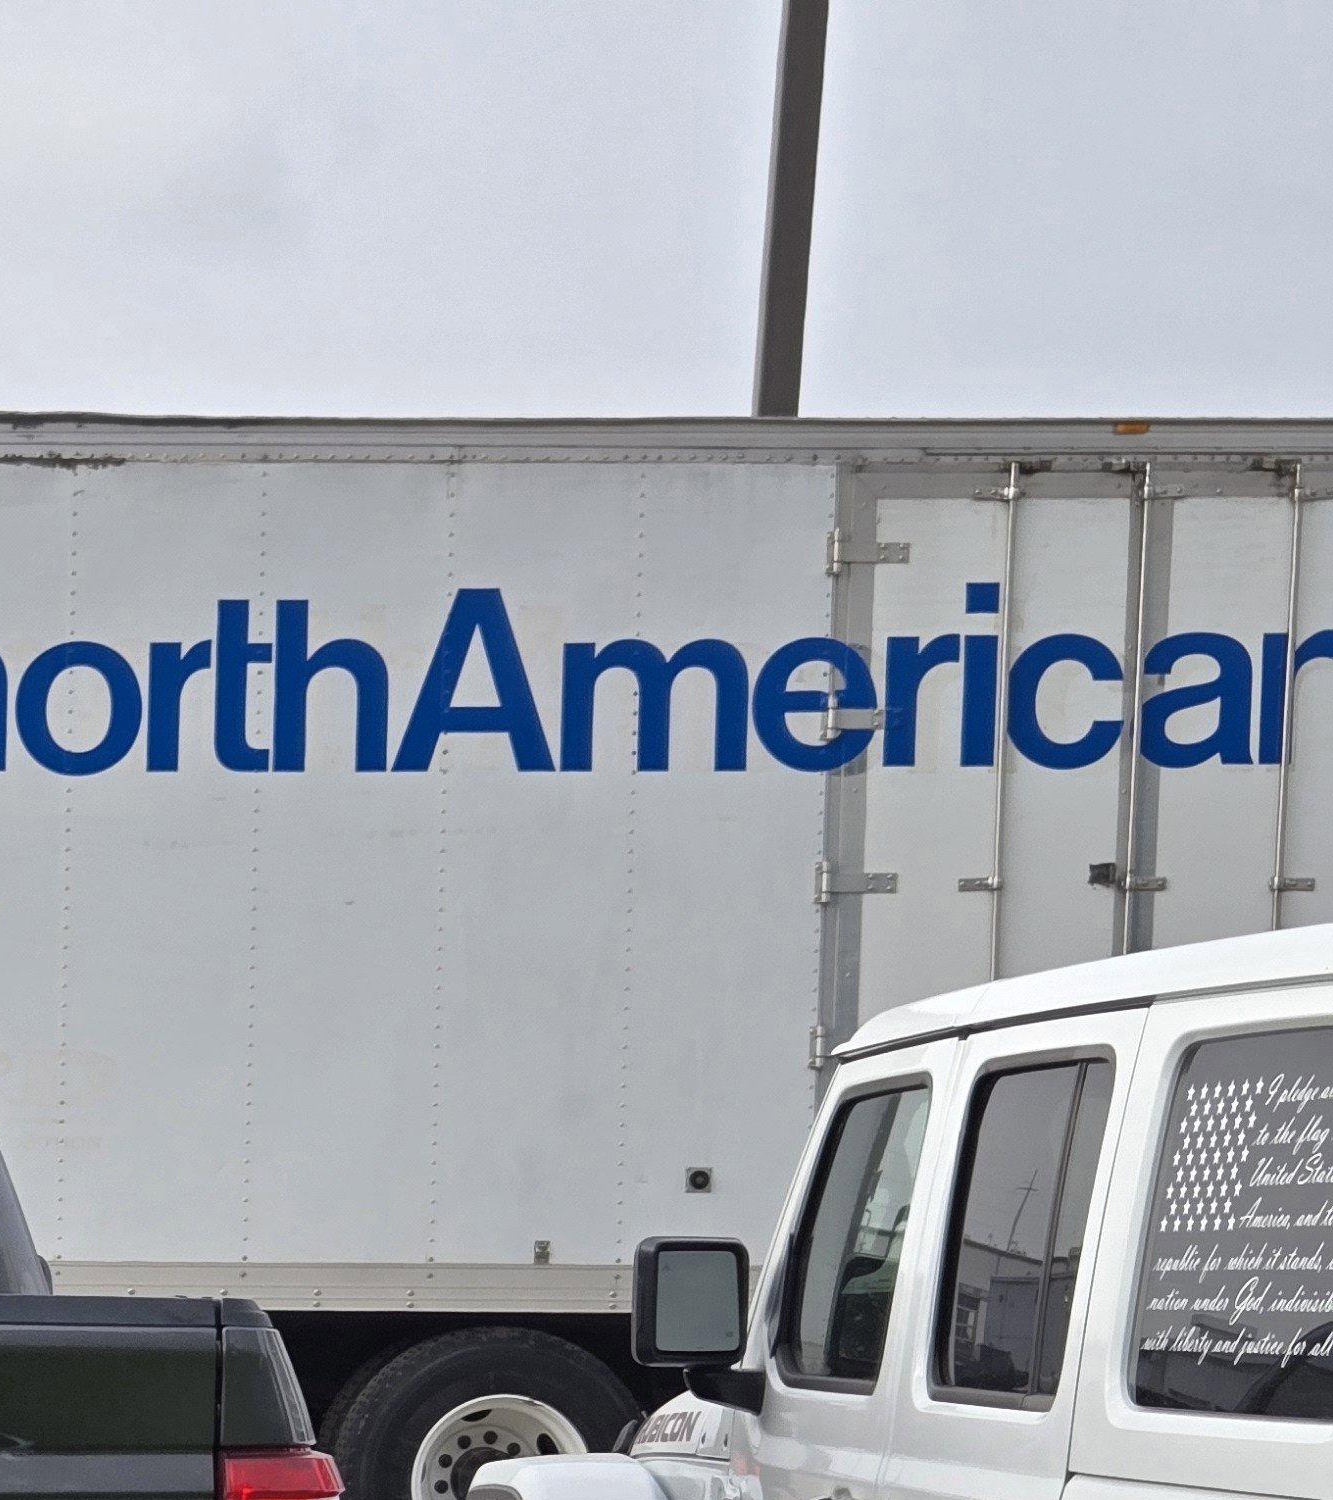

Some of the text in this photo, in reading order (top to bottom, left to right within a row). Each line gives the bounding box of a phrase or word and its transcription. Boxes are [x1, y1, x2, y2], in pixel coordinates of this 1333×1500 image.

[1273, 1074, 1320, 1114] pledge
[1251, 1114, 1330, 1156] to the flag
[1249, 1156, 1305, 1187] United
[1293, 1200, 1328, 1227] and
[1152, 1244, 1201, 1281] republic
[1198, 1243, 1222, 1284] for
[1224, 1242, 1268, 1271] which
[1263, 1247, 1282, 1271] it
[1146, 1288, 1189, 1311] nation
[1190, 1285, 1230, 1311] under
[1139, 1325, 1173, 1351] with
[1169, 1326, 1211, 1366] liberty
[1210, 1327, 1246, 1353] and
[1233, 1332, 1284, 1366] justice
[1280, 1327, 1307, 1369] for
